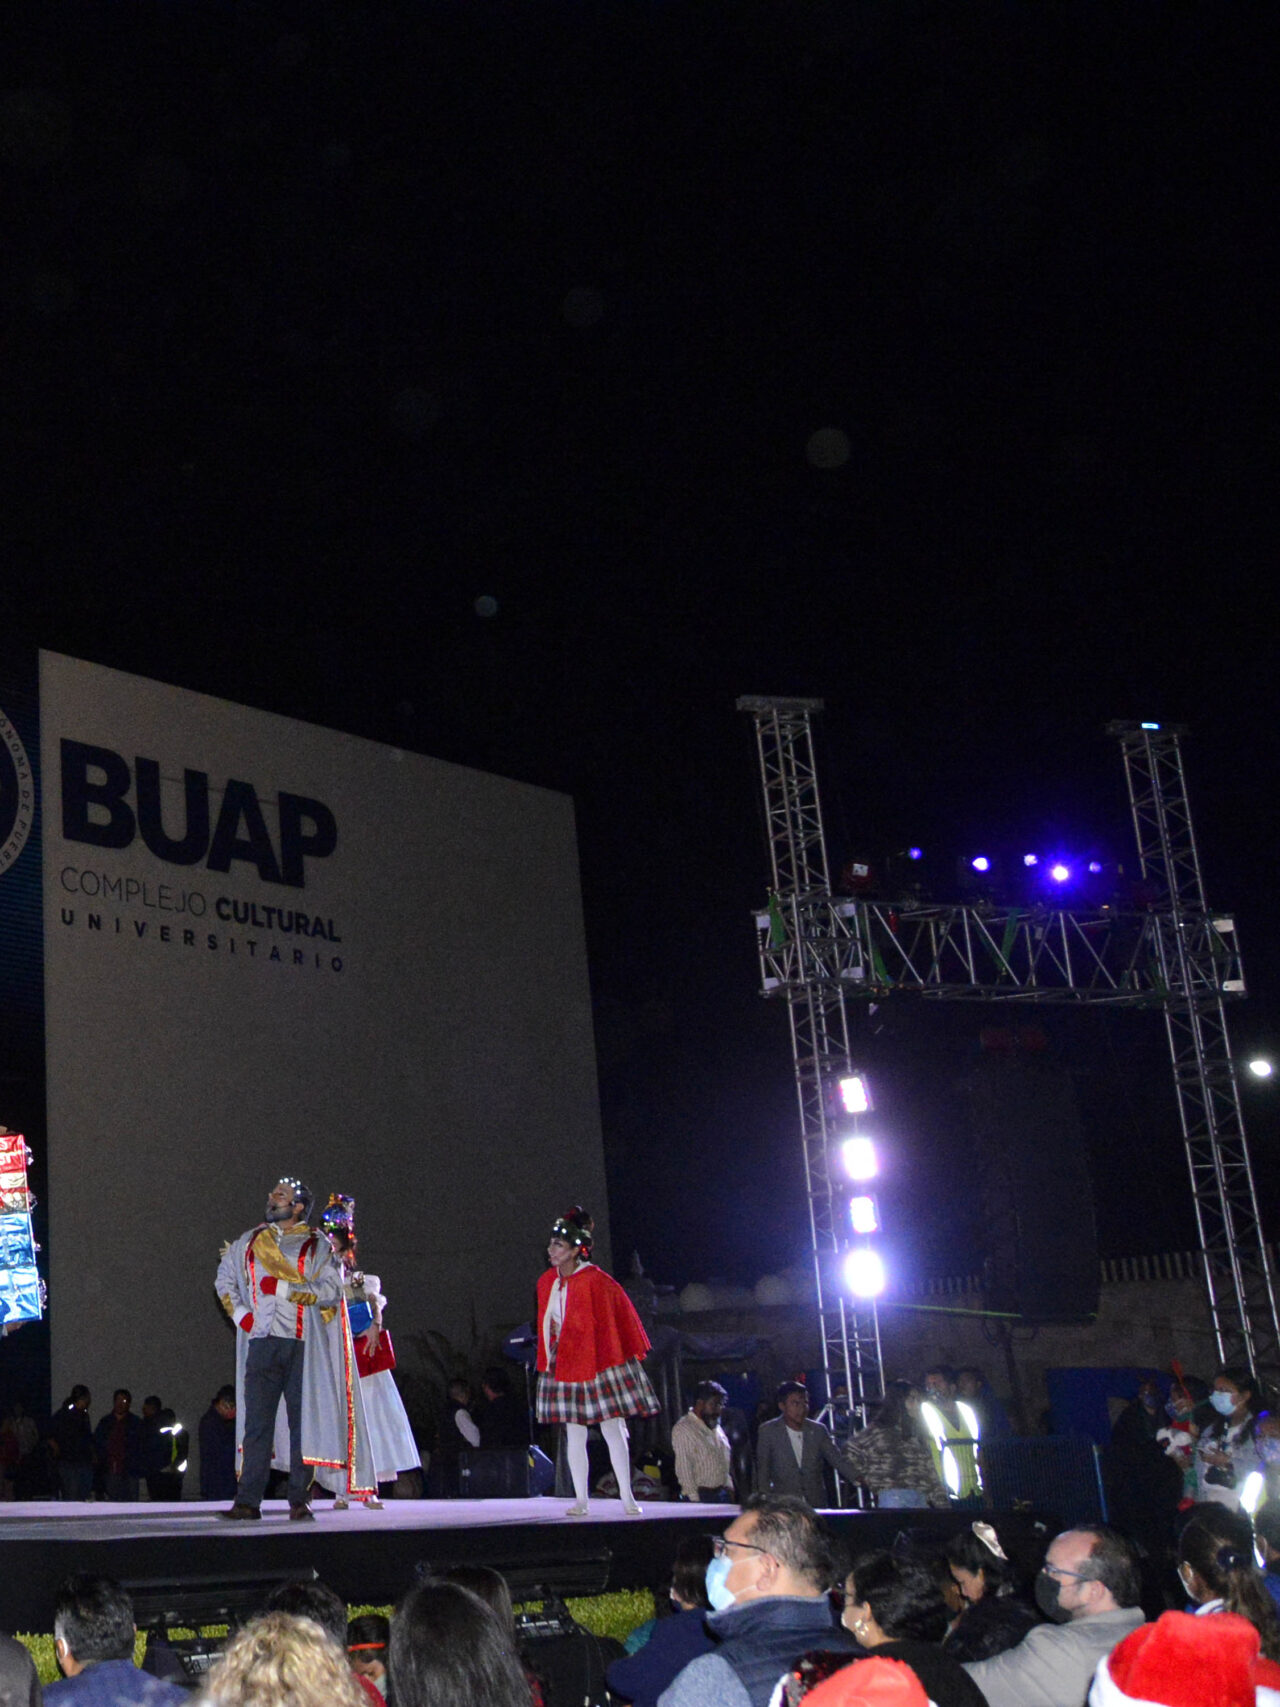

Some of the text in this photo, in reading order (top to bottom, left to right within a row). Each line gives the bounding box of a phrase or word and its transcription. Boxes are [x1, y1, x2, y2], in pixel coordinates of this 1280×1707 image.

[21, 789, 31, 812] DE
[60, 737, 337, 888] BUAP
[60, 867, 342, 943] COMPLEJO CULTURAL
[61, 908, 343, 972] UNIVERSITARIO
